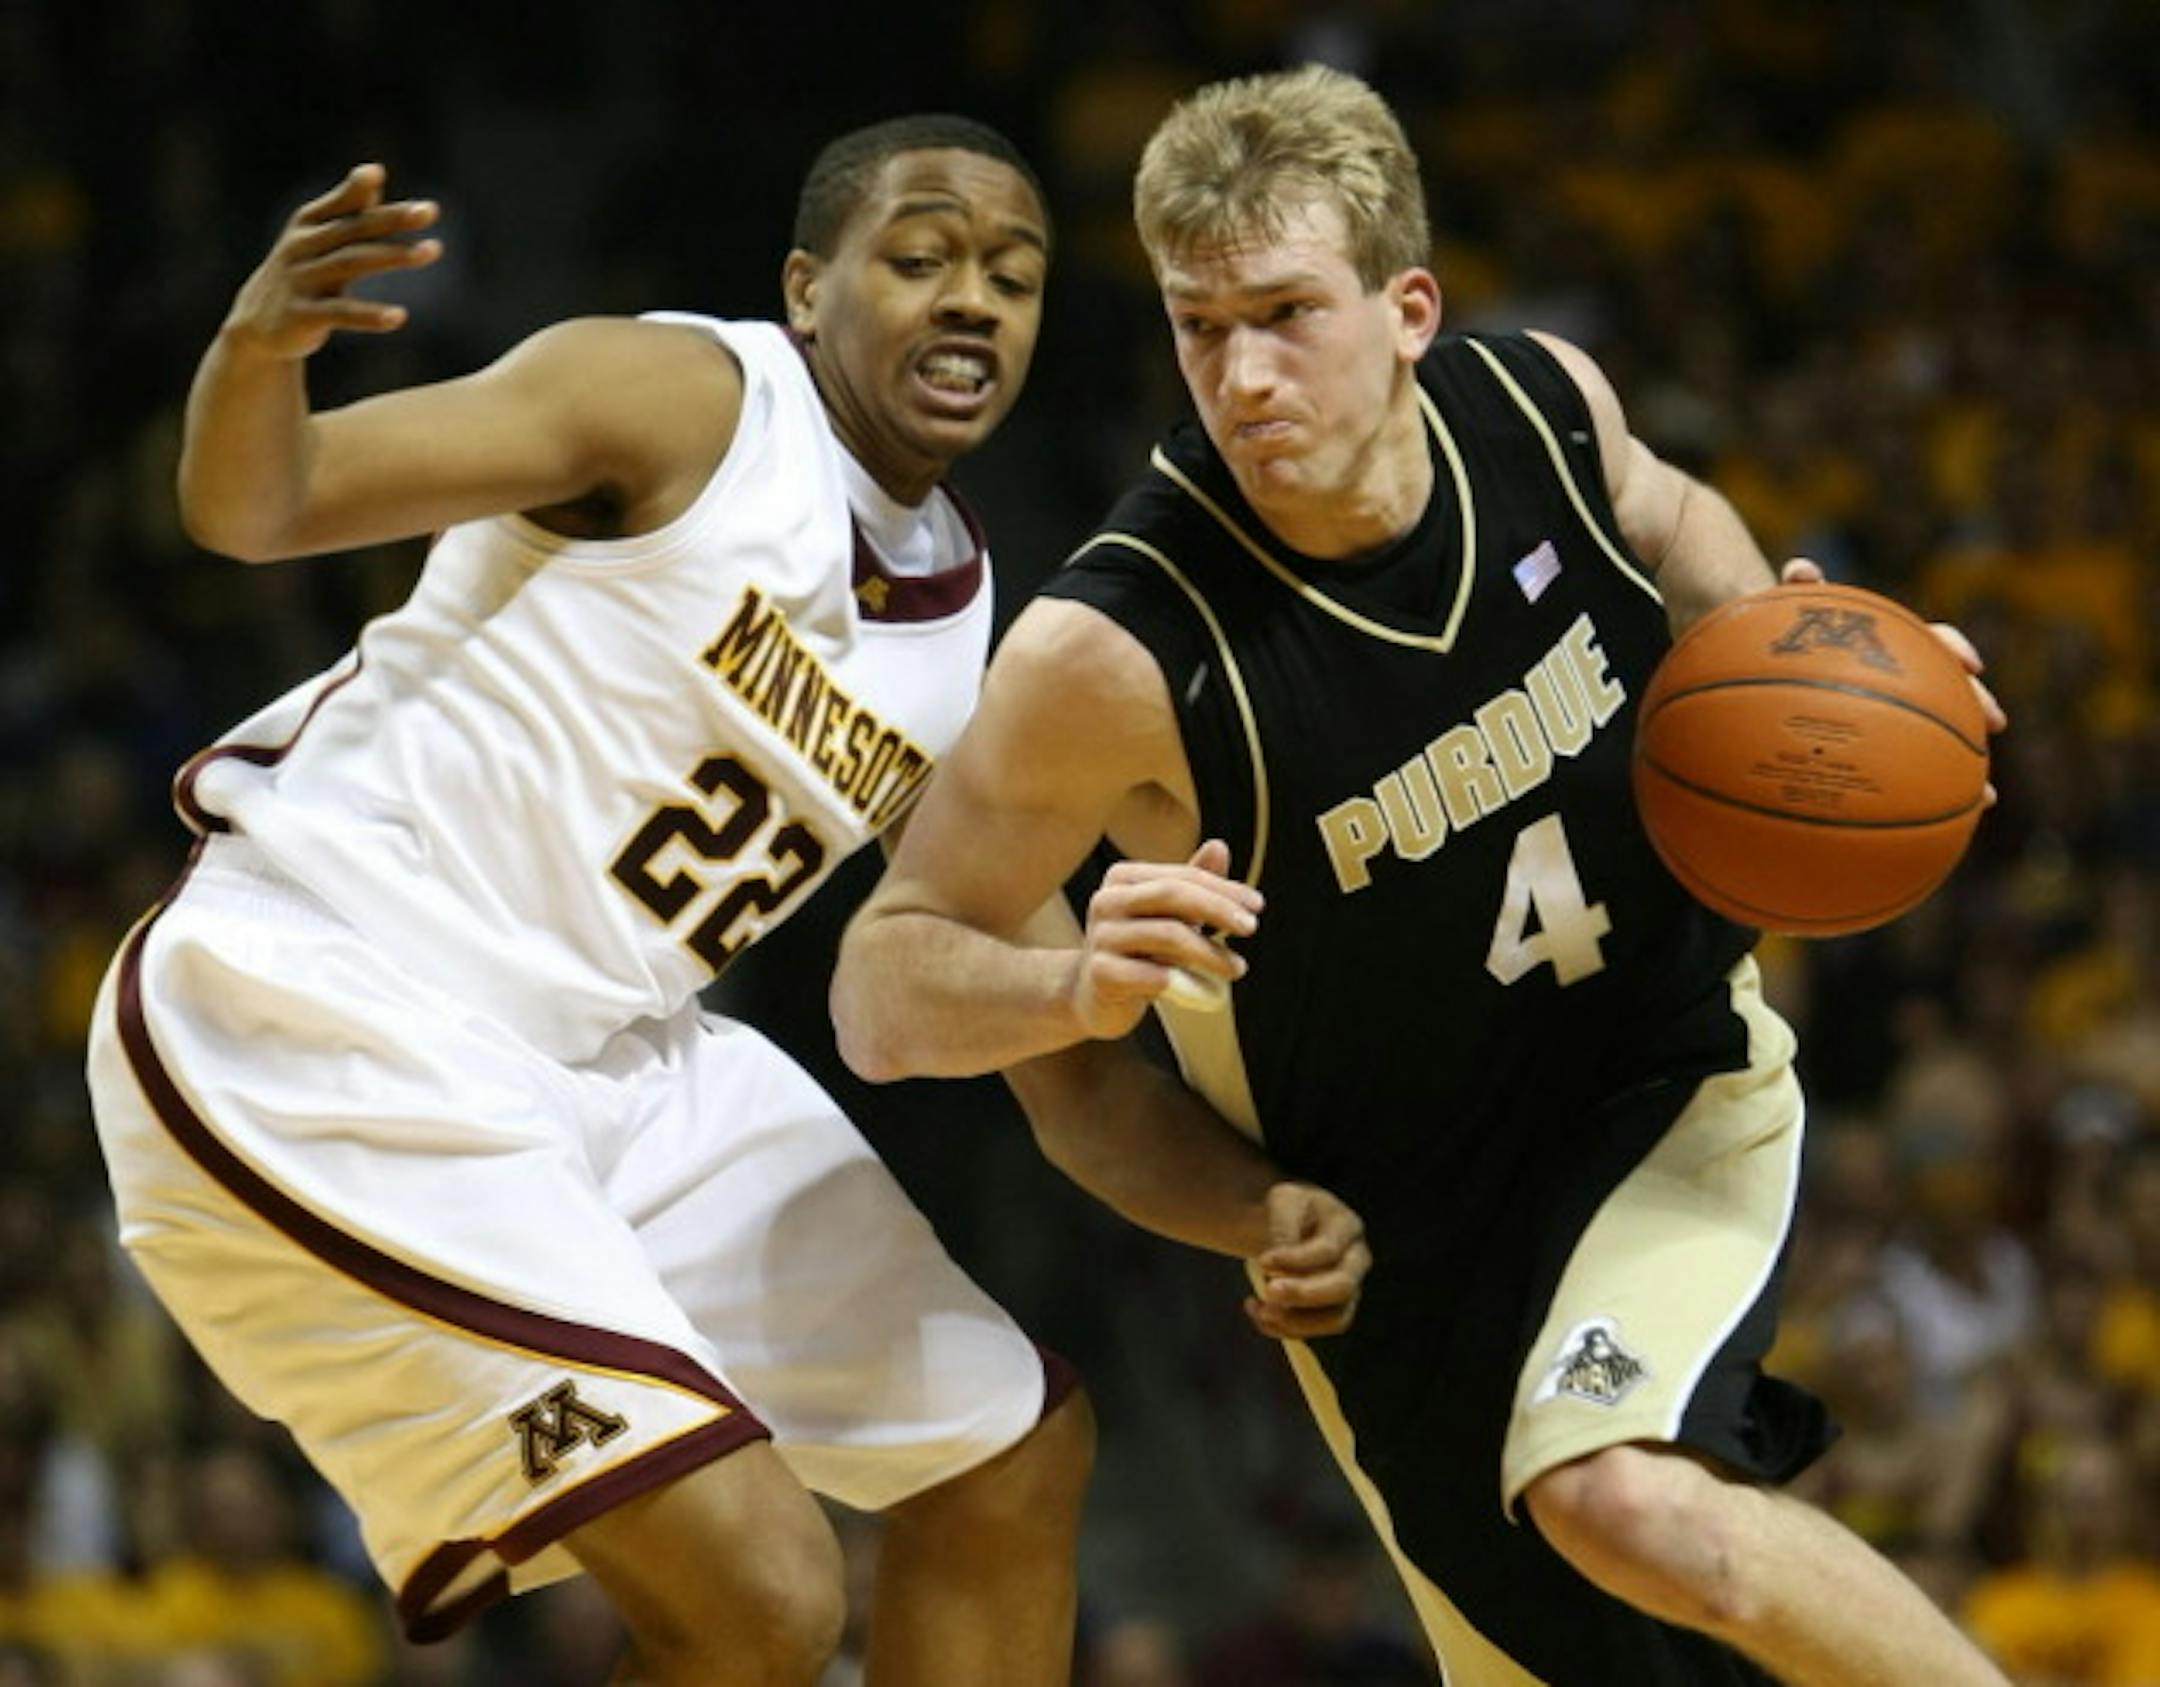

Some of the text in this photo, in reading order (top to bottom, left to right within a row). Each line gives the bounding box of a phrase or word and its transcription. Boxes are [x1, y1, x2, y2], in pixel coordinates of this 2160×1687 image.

[1316, 612, 1627, 893] PURDUE
[608, 752, 826, 978] 22
[1485, 811, 1613, 986] 4
[508, 1378, 630, 1488] M
